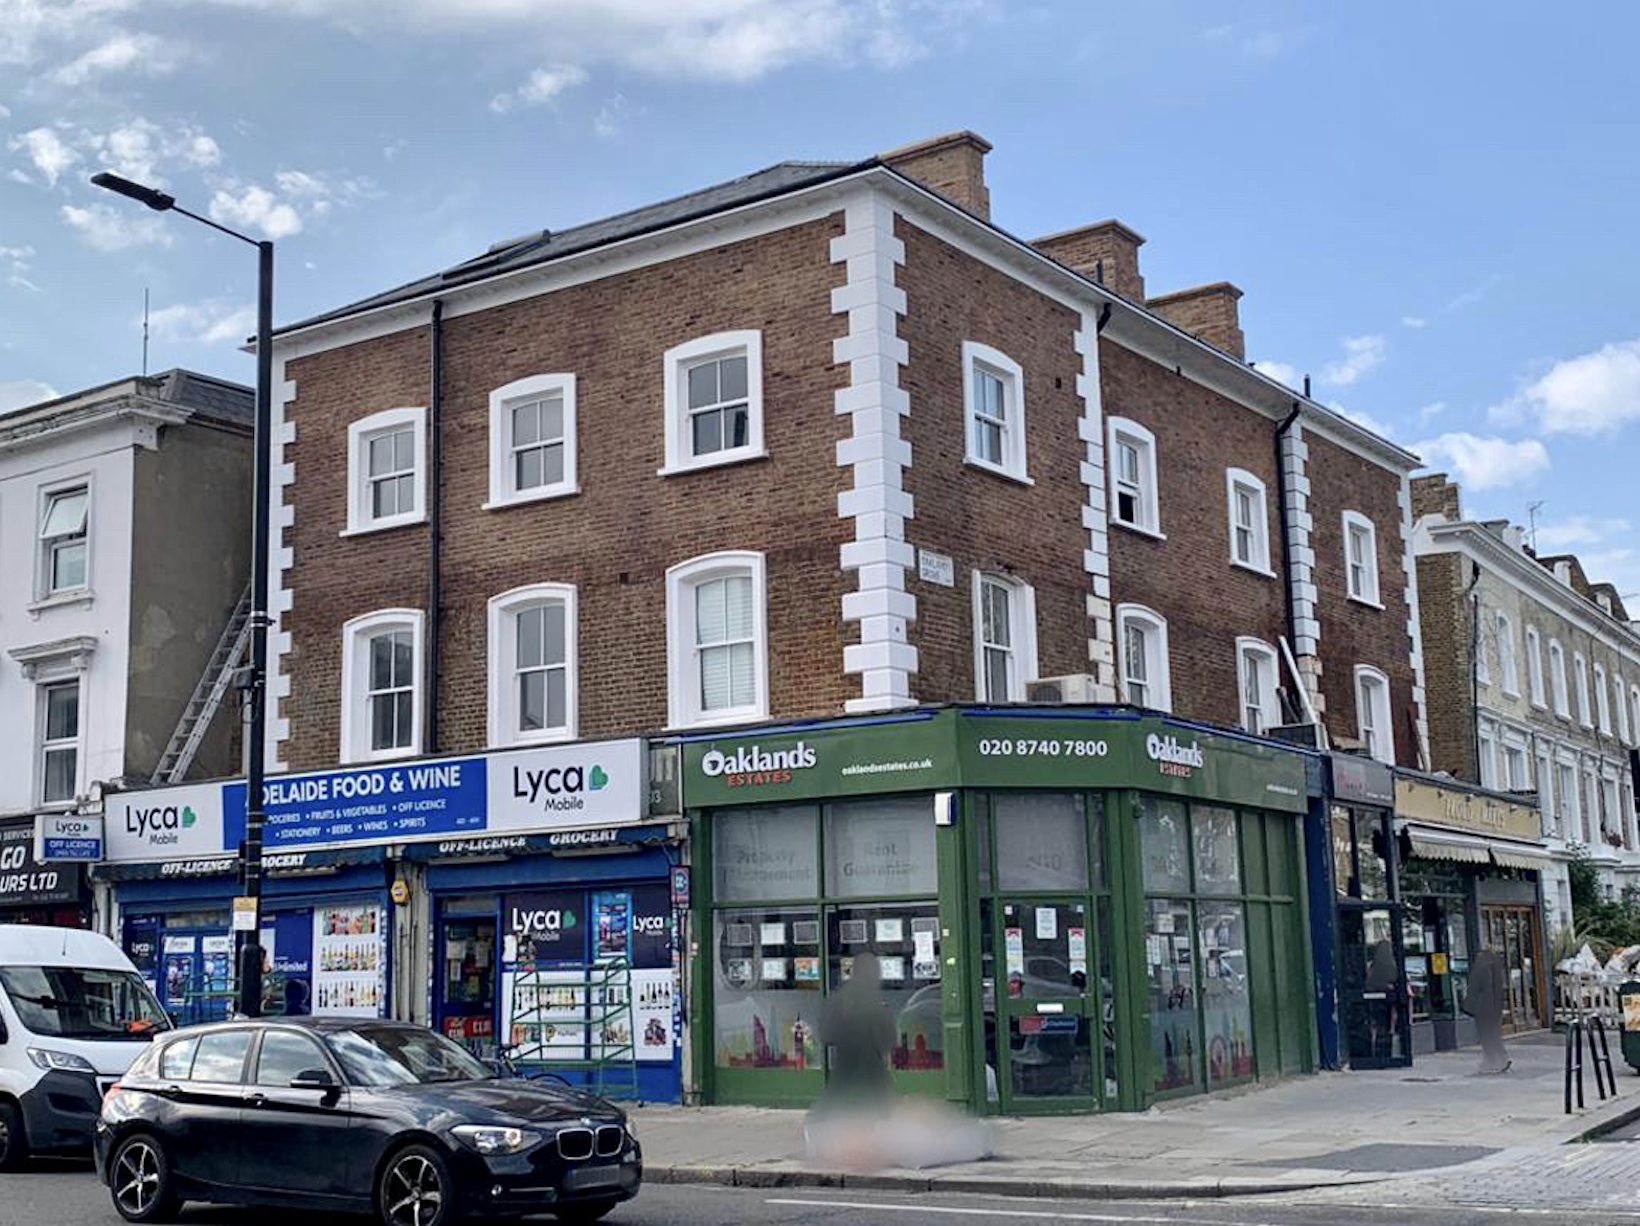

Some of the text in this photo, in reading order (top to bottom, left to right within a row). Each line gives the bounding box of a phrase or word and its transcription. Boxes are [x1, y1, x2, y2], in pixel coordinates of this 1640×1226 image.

[979, 739, 1108, 757] 020 8740 7800
[1146, 733, 1203, 768] Oaklands
[702, 741, 816, 776] Oaklands
[841, 758, 933, 777] oaklandsestates.co.uk
[262, 765, 461, 805] DELAIDE FOOD & WINE
[513, 766, 584, 804] Lyca
[725, 770, 792, 787] ESTATES
[311, 810, 335, 820] FRUITS
[342, 804, 387, 818] VEGETABLES
[398, 801, 413, 813] OFF
[414, 798, 447, 811] LICENCE
[544, 796, 584, 812] Mobile
[56, 820, 81, 833] Lyca
[126, 805, 179, 838] Lyca
[280, 816, 427, 838] STATIONERY BEERS WINES SPIRITS
[149, 832, 179, 845] Mobile
[439, 829, 620, 853] OFF-LICENCE GROCERY
[161, 860, 233, 875] OFF-LICENCE
[29, 872, 58, 891] LTD
[512, 908, 561, 934] Lyca
[633, 915, 664, 933] Lyca
